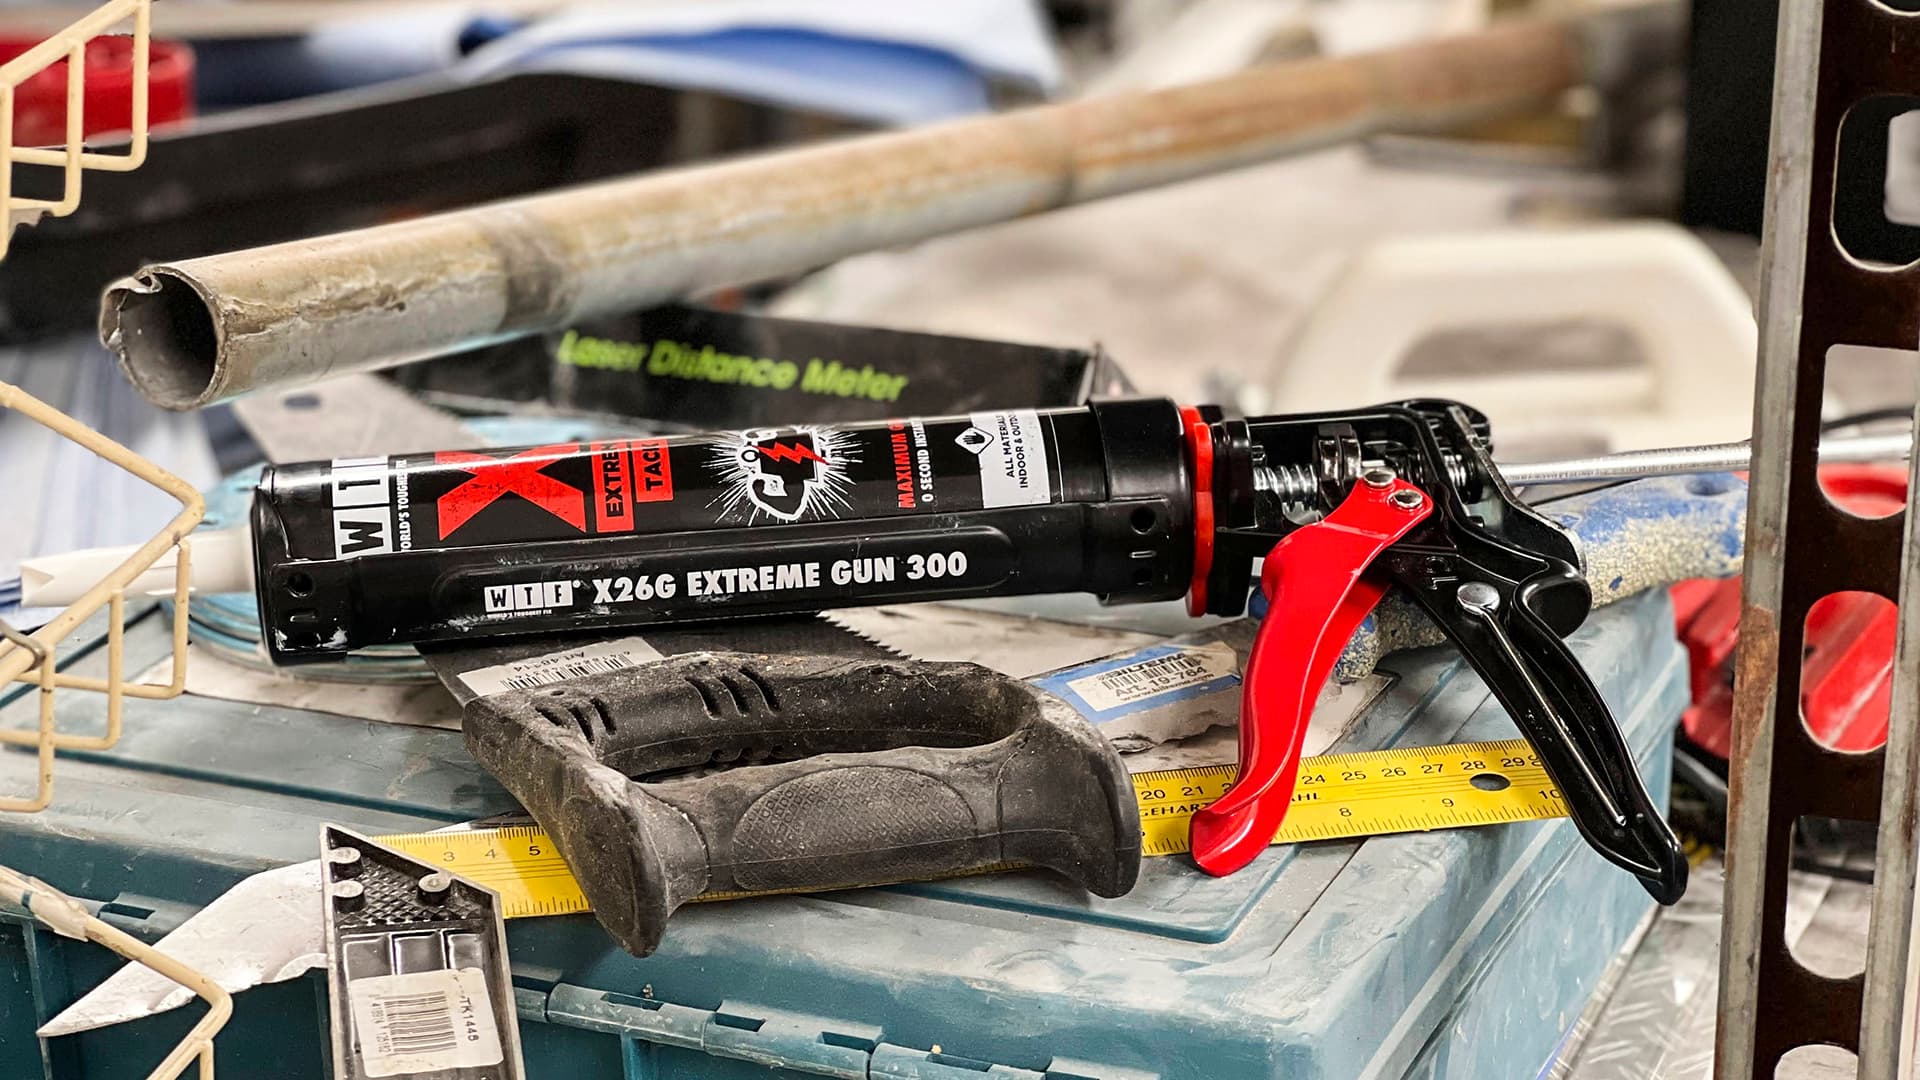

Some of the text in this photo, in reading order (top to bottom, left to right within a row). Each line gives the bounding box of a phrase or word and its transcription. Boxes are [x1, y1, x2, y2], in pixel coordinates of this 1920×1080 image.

[557, 329, 909, 402] Laser Distance Meter
[891, 432, 916, 509] MAXIMUM
[916, 449, 933, 490] SECOND
[1003, 457, 1015, 478] ALL
[1014, 445, 1029, 488] INDOOR
[398, 508, 413, 552] ORLD'S
[593, 573, 677, 604] X26G
[687, 562, 821, 596] EXTREME
[830, 557, 896, 587] GUN
[906, 551, 968, 579] 300
[1115, 666, 1208, 698] Art. 19-764
[1141, 788, 1166, 801] 20
[1181, 785, 1205, 797] 21
[1303, 773, 1326, 785] 24
[1342, 769, 1367, 782] 25
[1382, 766, 1406, 778] 26
[1421, 763, 1445, 774] 27
[1462, 759, 1487, 771] 28
[1501, 756, 1525, 768] 29
[1339, 807, 1352, 817] 8
[1442, 797, 1455, 809] 9
[443, 845, 541, 862] 3 4 5
